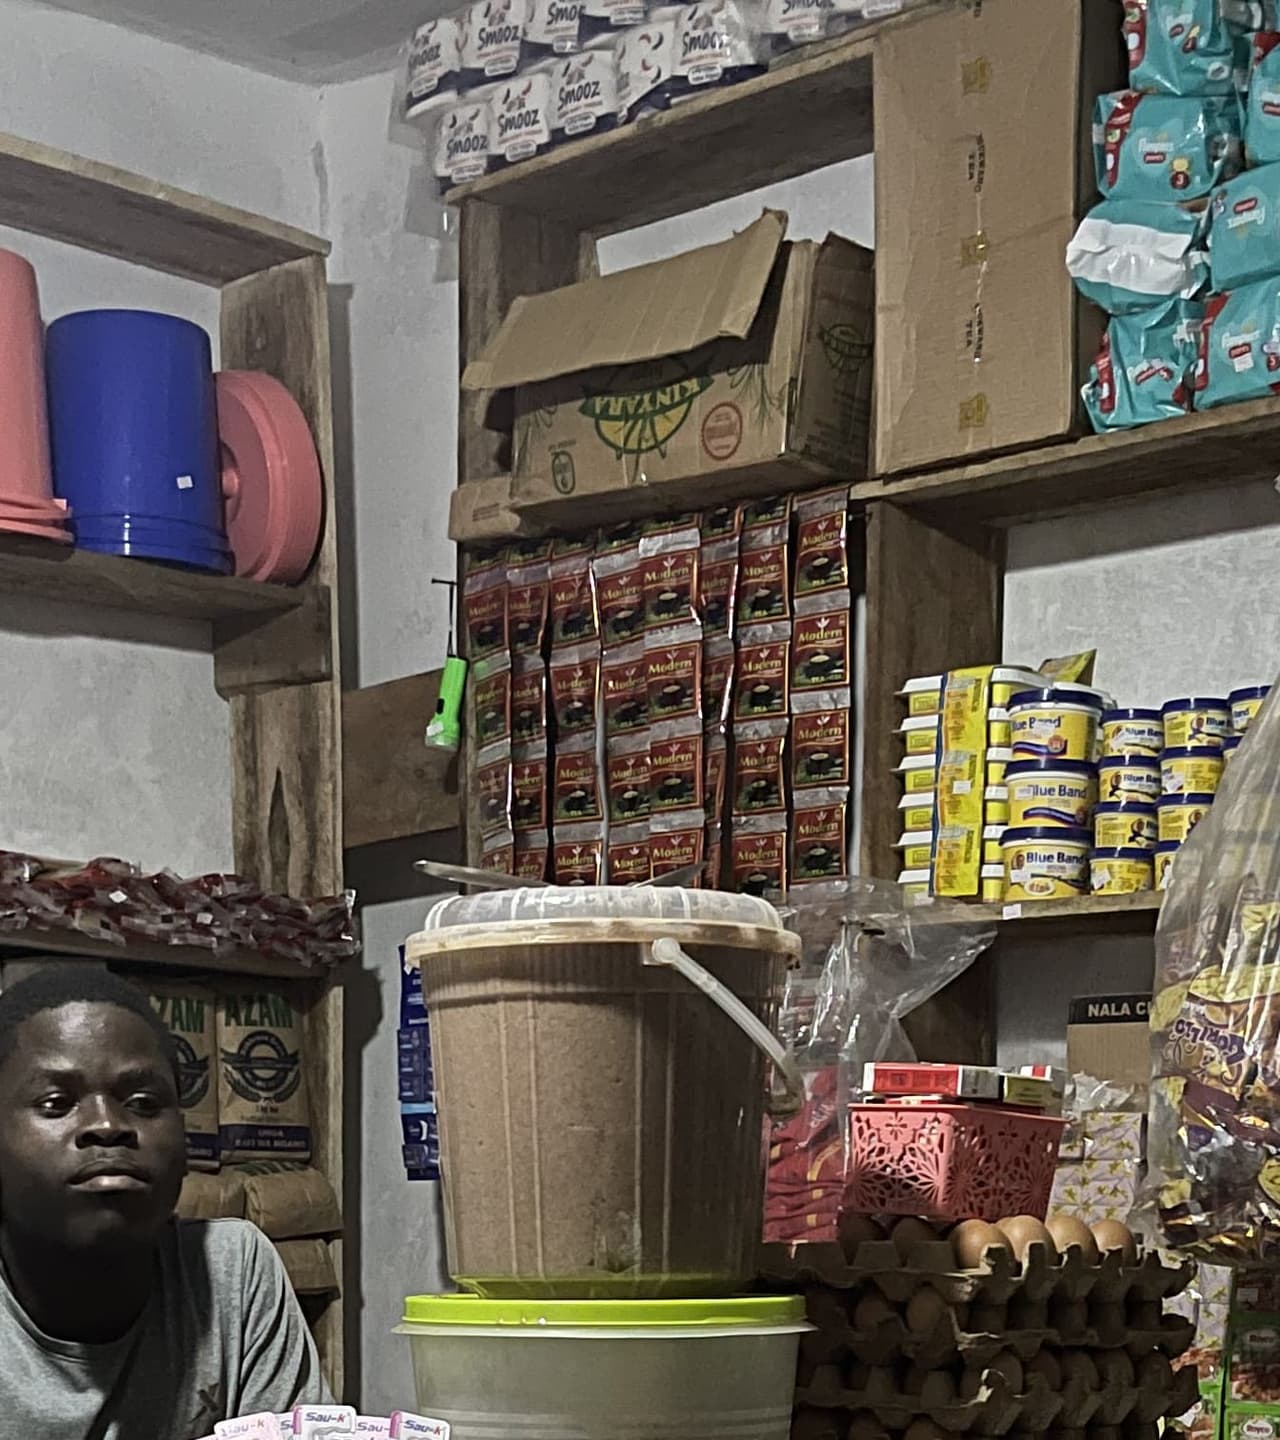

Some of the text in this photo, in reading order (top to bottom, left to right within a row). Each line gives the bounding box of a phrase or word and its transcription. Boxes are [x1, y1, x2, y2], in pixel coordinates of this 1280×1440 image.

[478, 25, 520, 50] Smooz
[558, 81, 601, 110] Smooz
[497, 109, 540, 136] Smooz
[447, 134, 488, 159] Smooz
[802, 528, 840, 546] Modern
[644, 565, 689, 582] Modern
[799, 628, 843, 642] Modern
[648, 659, 692, 674] Modern
[799, 726, 842, 740] Modern
[653, 752, 693, 766] Modern
[1058, 786, 1087, 798] Band
[799, 821, 839, 835] Modern
[653, 846, 693, 859] Modern
[737, 850, 779, 863] Modern
[1027, 852, 1085, 864] Blue Band
[557, 855, 593, 867] Modern
[223, 994, 294, 1028] AZAM
[1088, 1002, 1131, 1018] NALA
[305, 1411, 346, 1423] Sau-k
[357, 1422, 389, 1434] Sau-
[404, 1419, 442, 1436] Sau-k
[1245, 1423, 1270, 1434] Royco
